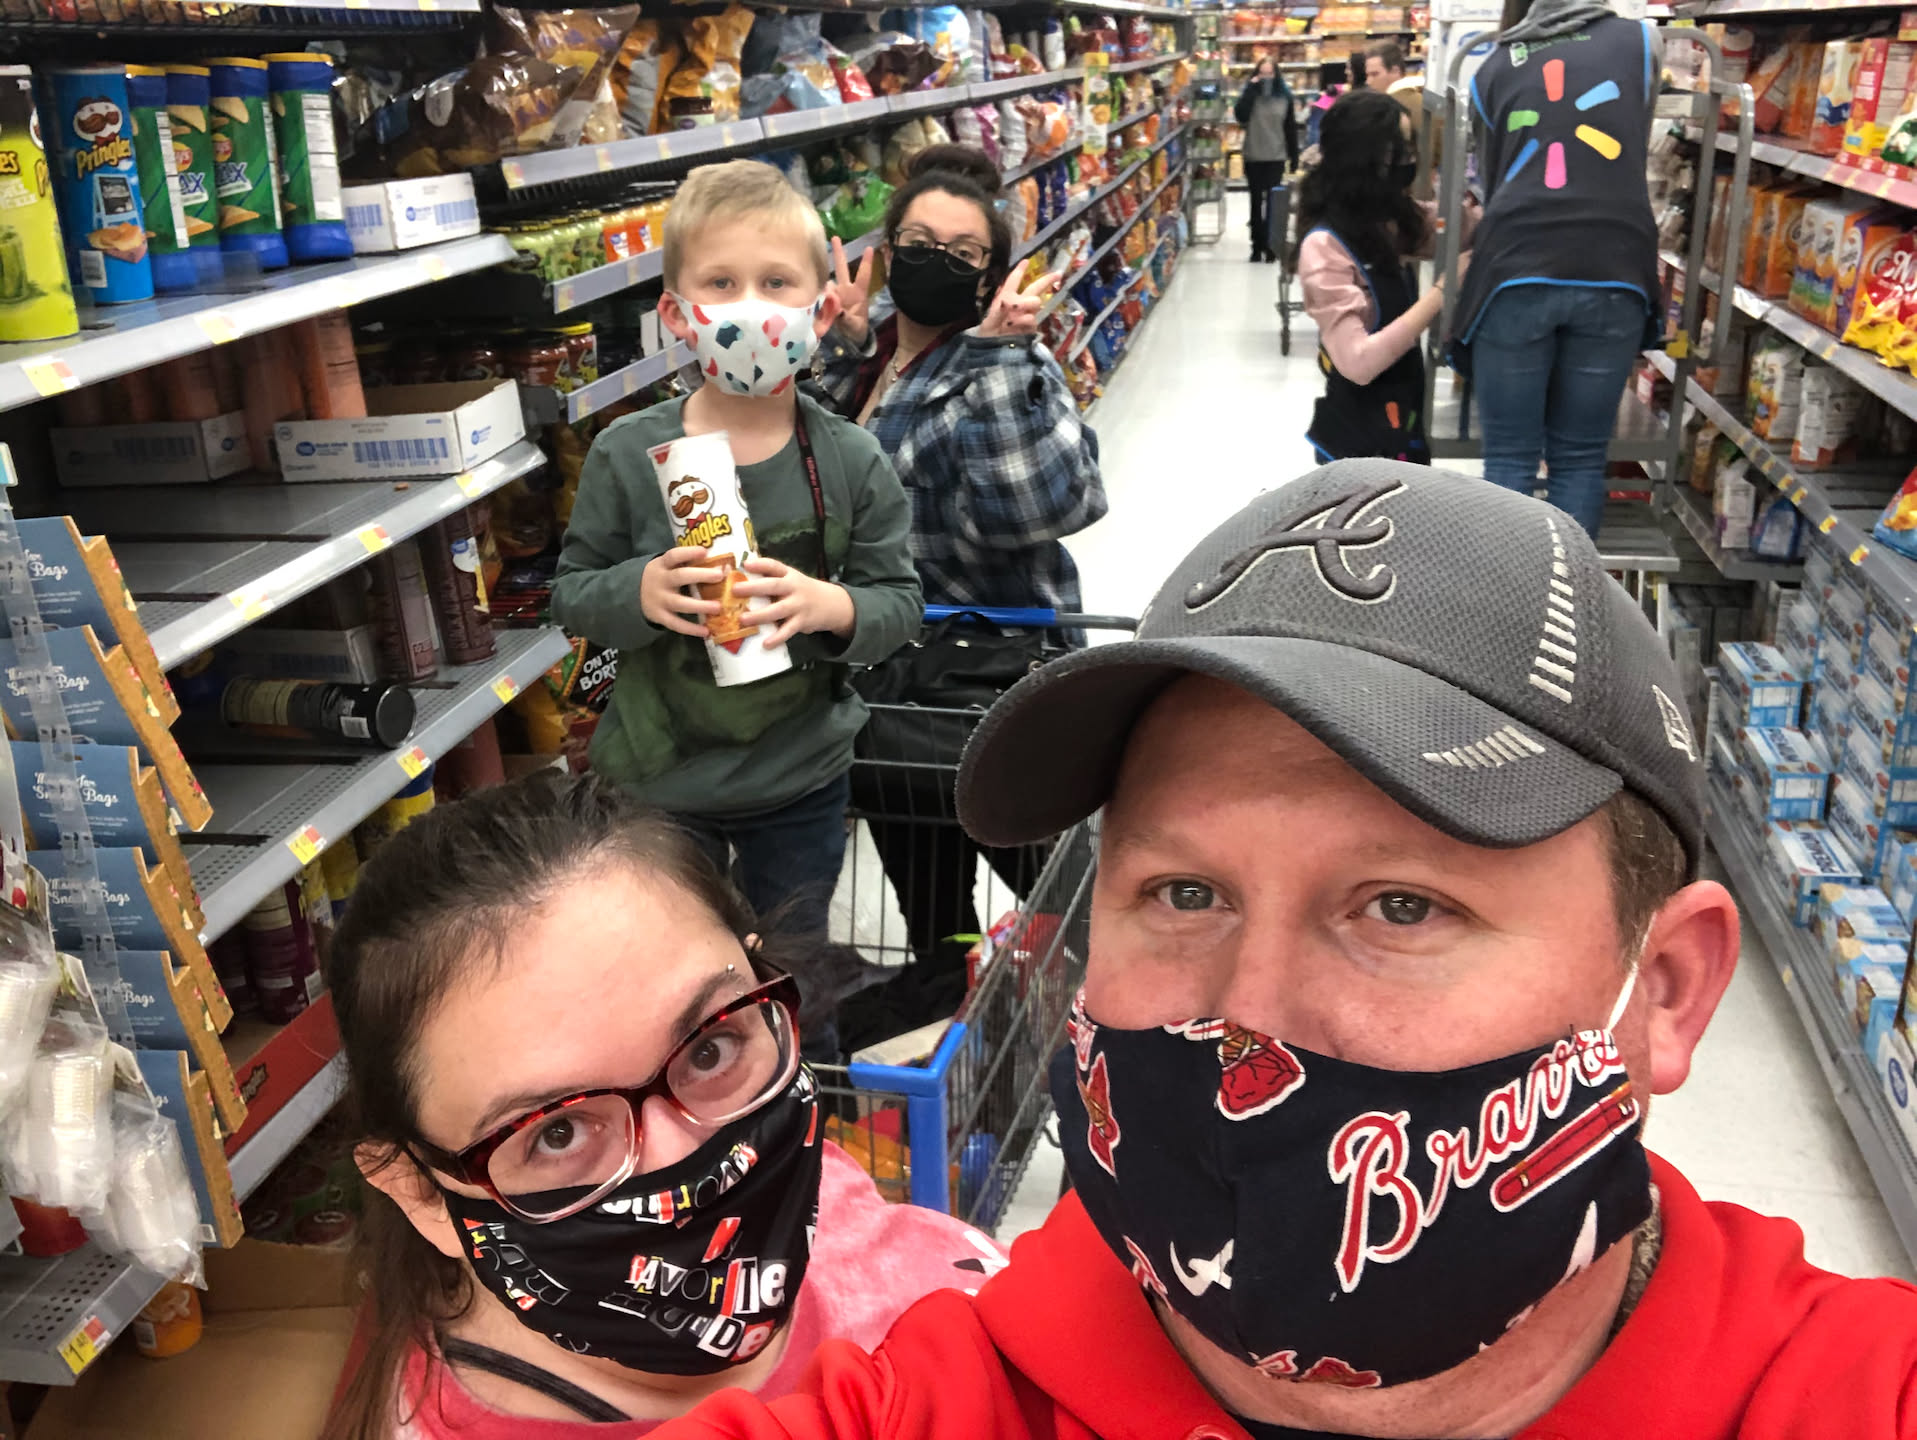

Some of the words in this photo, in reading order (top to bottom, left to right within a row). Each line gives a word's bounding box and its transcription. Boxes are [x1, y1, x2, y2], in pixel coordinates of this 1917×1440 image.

[29, 561, 68, 580] Bags
[583, 655, 603, 674] ON
[56, 673, 89, 691] Bags
[82, 787, 118, 807] Bags
[124, 990, 155, 1008] Bags
